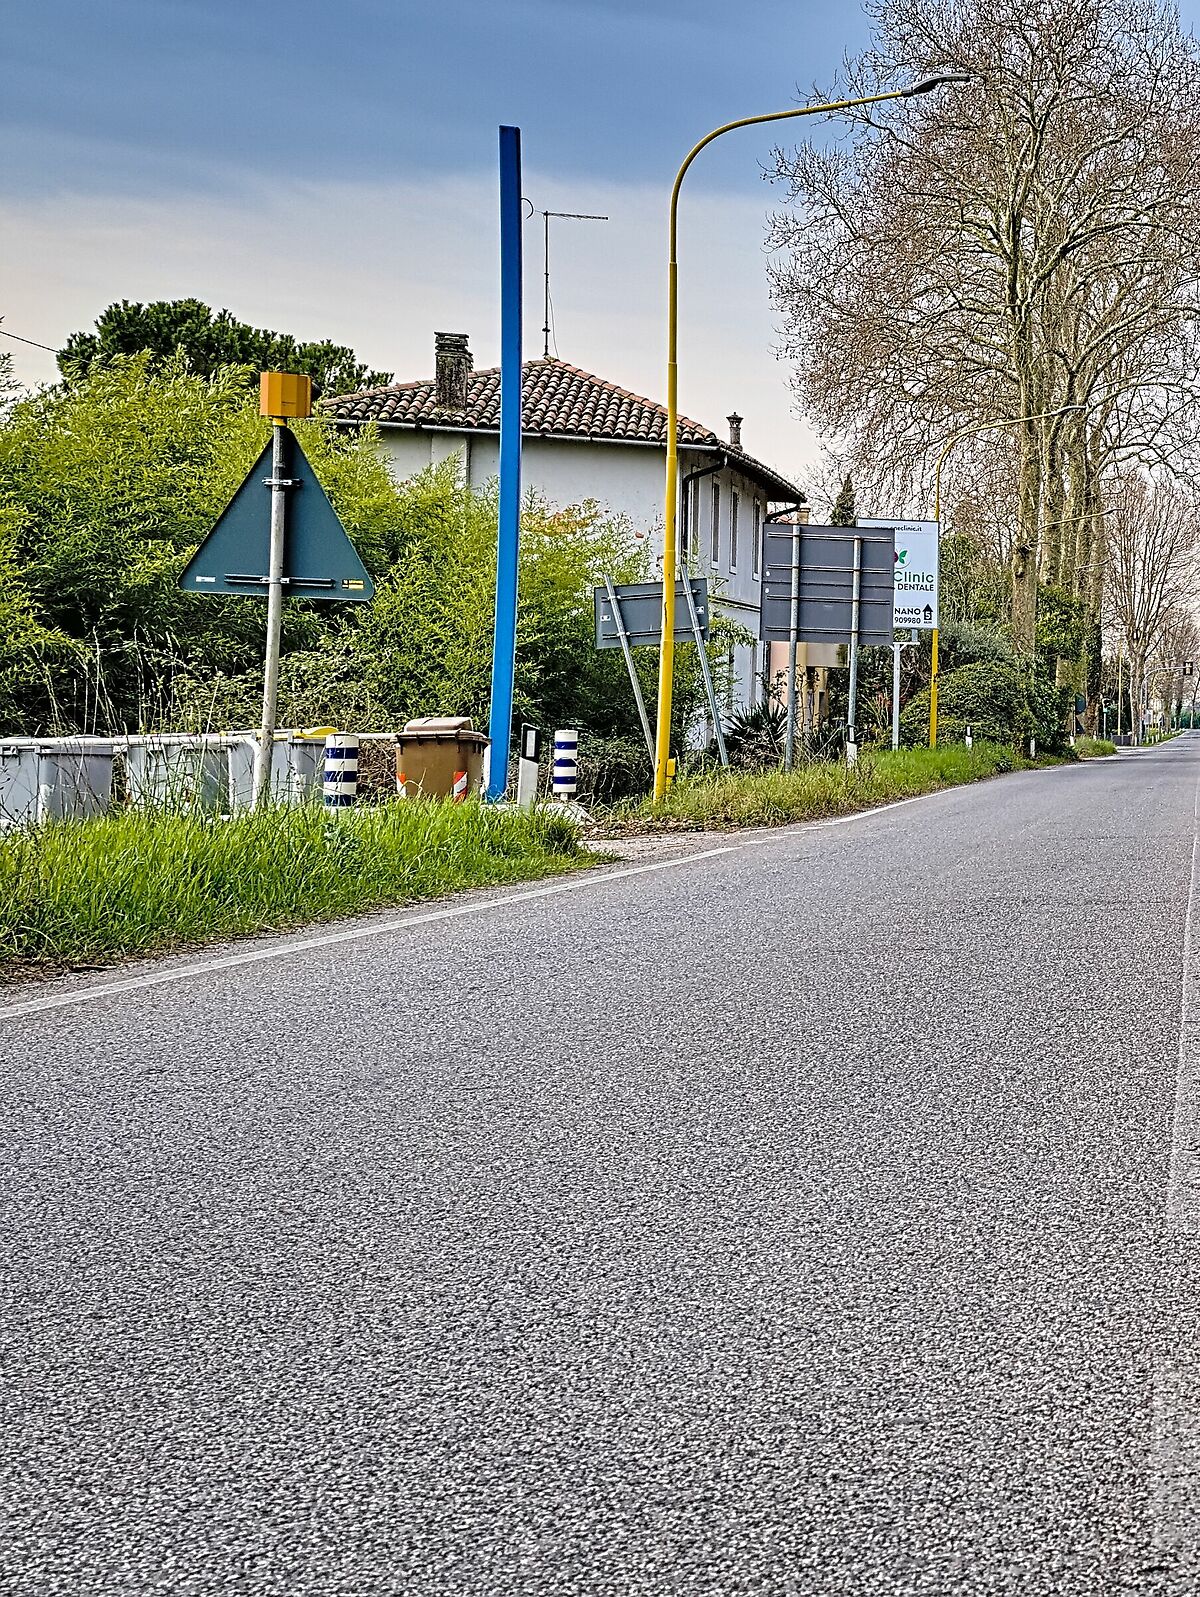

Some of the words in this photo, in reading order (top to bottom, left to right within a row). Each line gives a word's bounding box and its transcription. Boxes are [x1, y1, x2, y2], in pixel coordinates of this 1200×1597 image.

[893, 571, 934, 583] Clinic
[897, 583, 934, 591] DENTALE
[925, 611, 931, 620] 5
